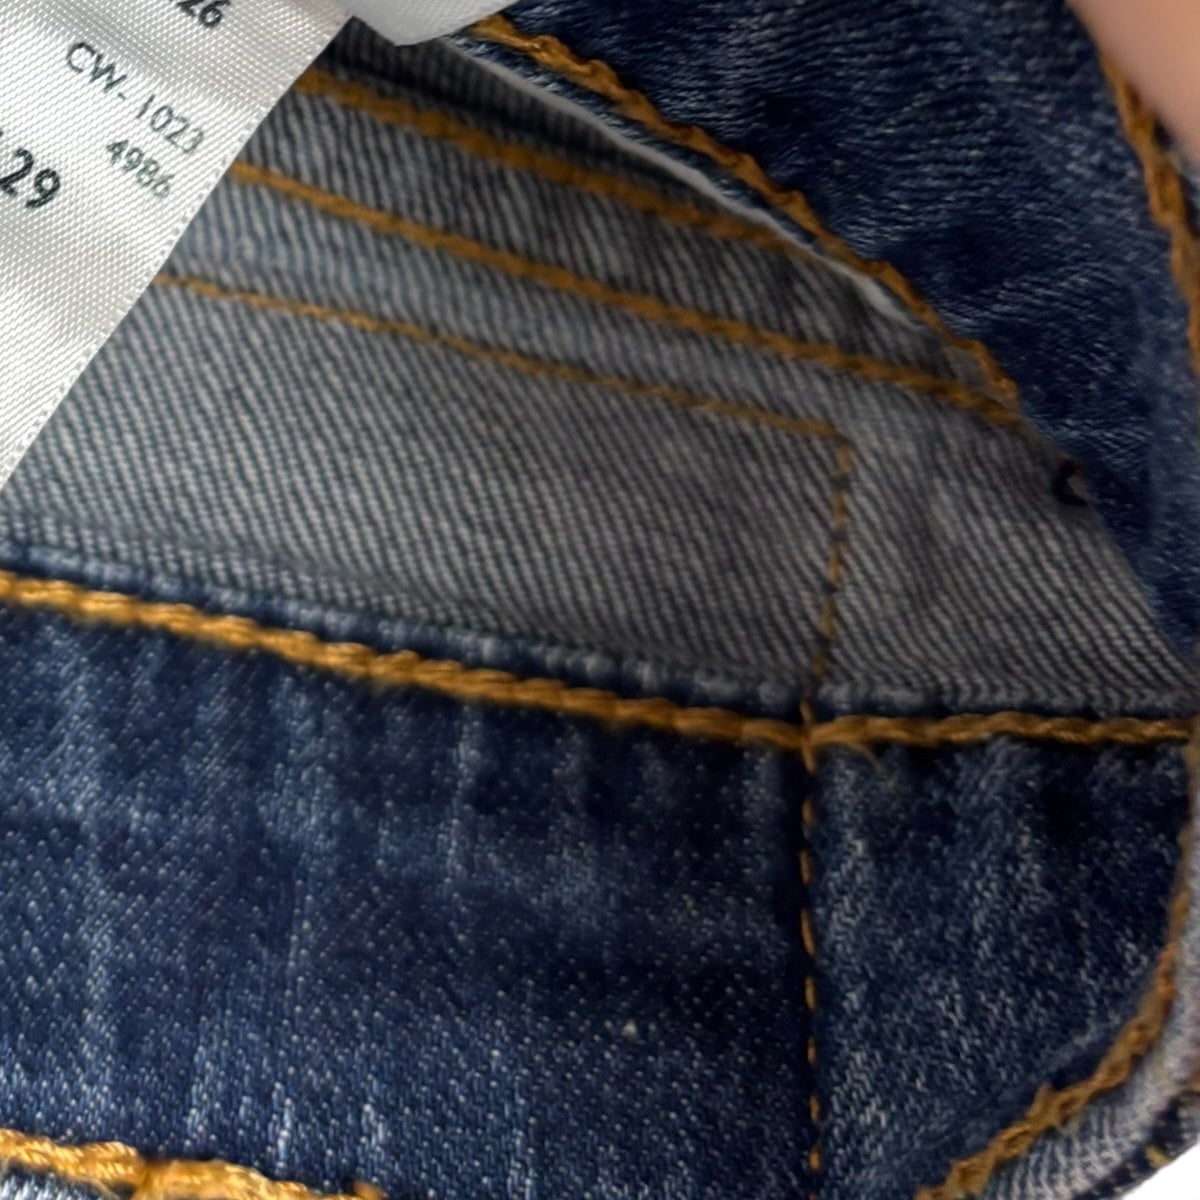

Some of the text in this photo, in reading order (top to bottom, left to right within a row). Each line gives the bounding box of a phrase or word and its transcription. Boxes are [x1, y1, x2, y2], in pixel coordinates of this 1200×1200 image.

[65, 41, 205, 154] CW- 1023
[105, 139, 171, 200] 4986
